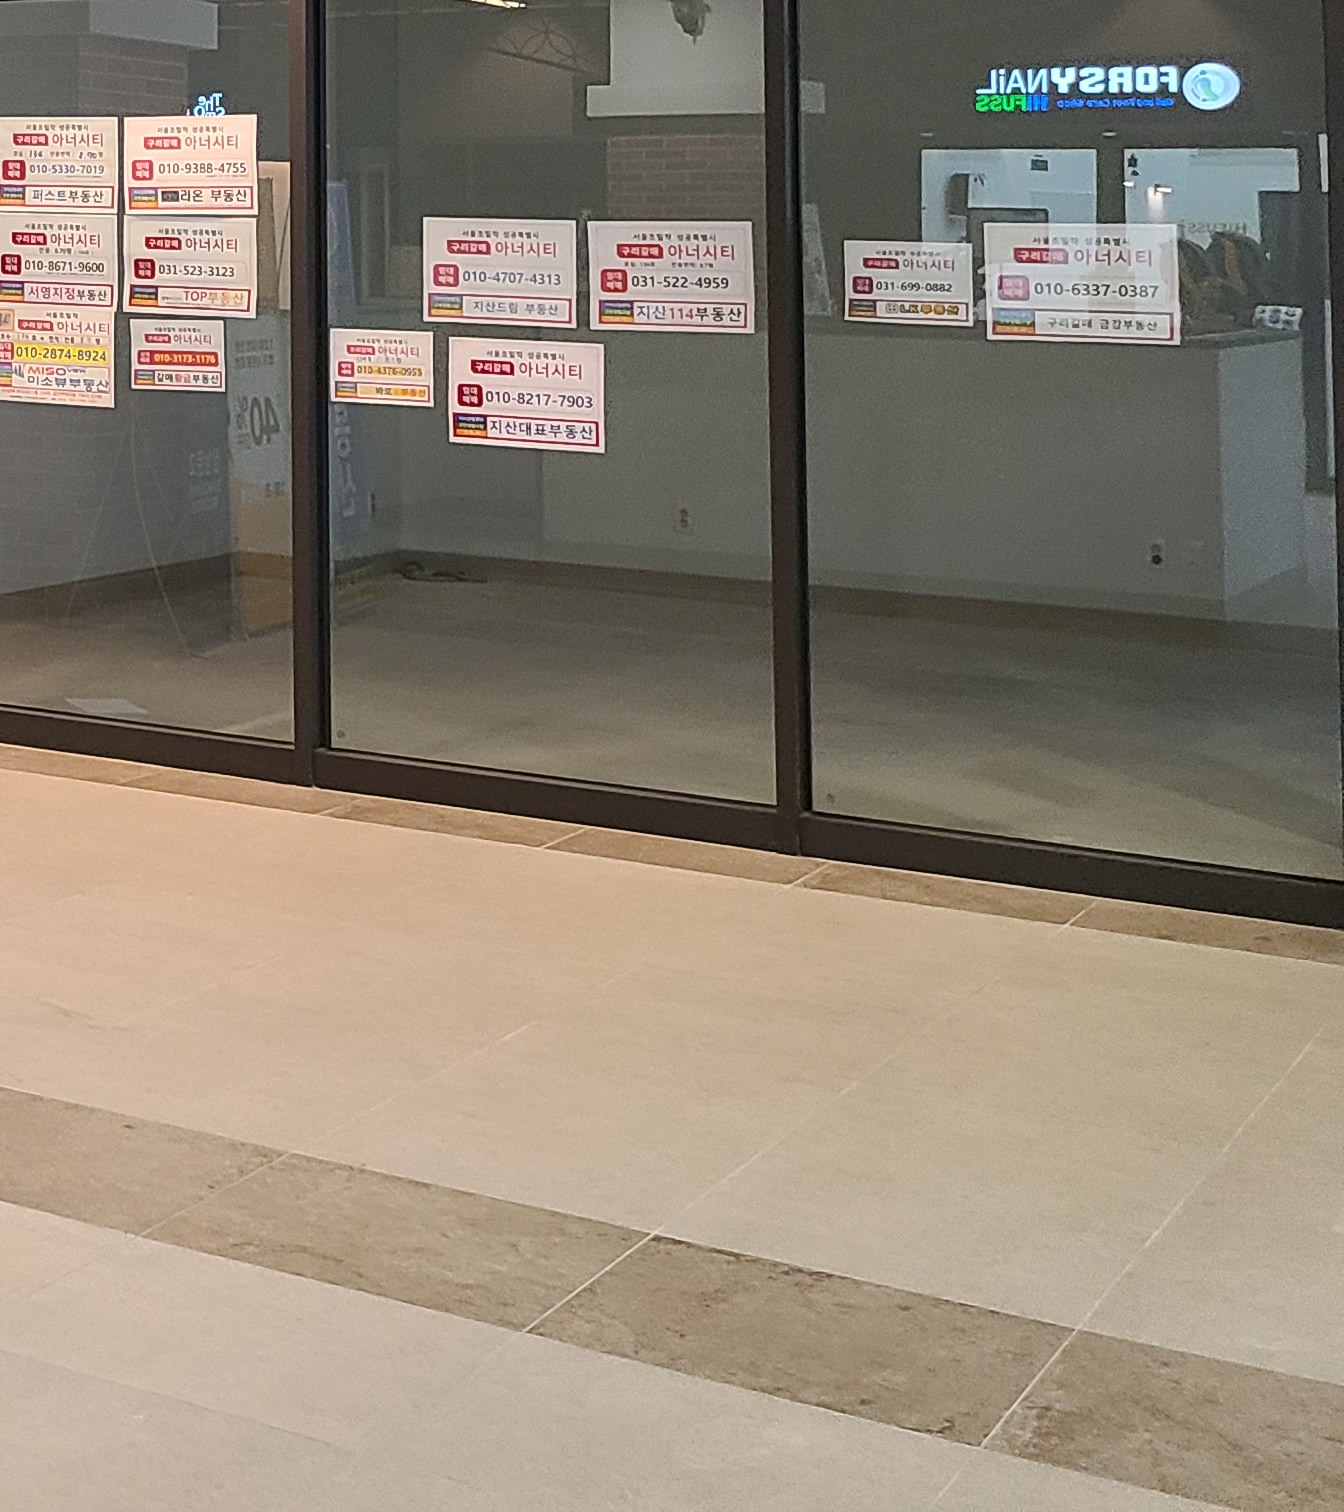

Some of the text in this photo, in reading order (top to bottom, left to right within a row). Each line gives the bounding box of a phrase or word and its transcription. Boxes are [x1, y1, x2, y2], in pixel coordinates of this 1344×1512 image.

[51, 133, 103, 147] 아너시티
[184, 135, 238, 150] 아너시티
[29, 165, 104, 174] 010-5330-7019
[158, 163, 246, 174] 010-9388-4755
[31, 190, 104, 203] 퍼스트부동산
[210, 190, 246, 202] 부동산
[50, 233, 100, 248] 아너시티
[185, 238, 237, 253] 아너시티
[494, 241, 556, 258] 아너시티
[667, 244, 735, 261] 아너시티
[1073, 248, 1152, 267] 아너시티
[24, 260, 104, 272] 010-8671-9600
[158, 264, 234, 277] 031-523-3123
[462, 271, 561, 285] 010-4707-4313
[631, 276, 729, 289] 031-522-4959
[28, 286, 107, 301] 서영지정부동산
[1033, 282, 1159, 298] 010-6337-0387
[182, 291, 243, 305] TOP부동산
[524, 303, 558, 316] 부동산
[636, 305, 742, 322] 지산114부동산
[56, 321, 109, 335] 아너시티
[15, 347, 107, 361] 010-2874-8924
[27, 366, 66, 376] MISO
[518, 362, 582, 380] 아너시티
[27, 376, 109, 393] 미소뷰부동산
[485, 391, 593, 408] 010-8217-7903
[489, 420, 593, 440] 지산대표부동산
